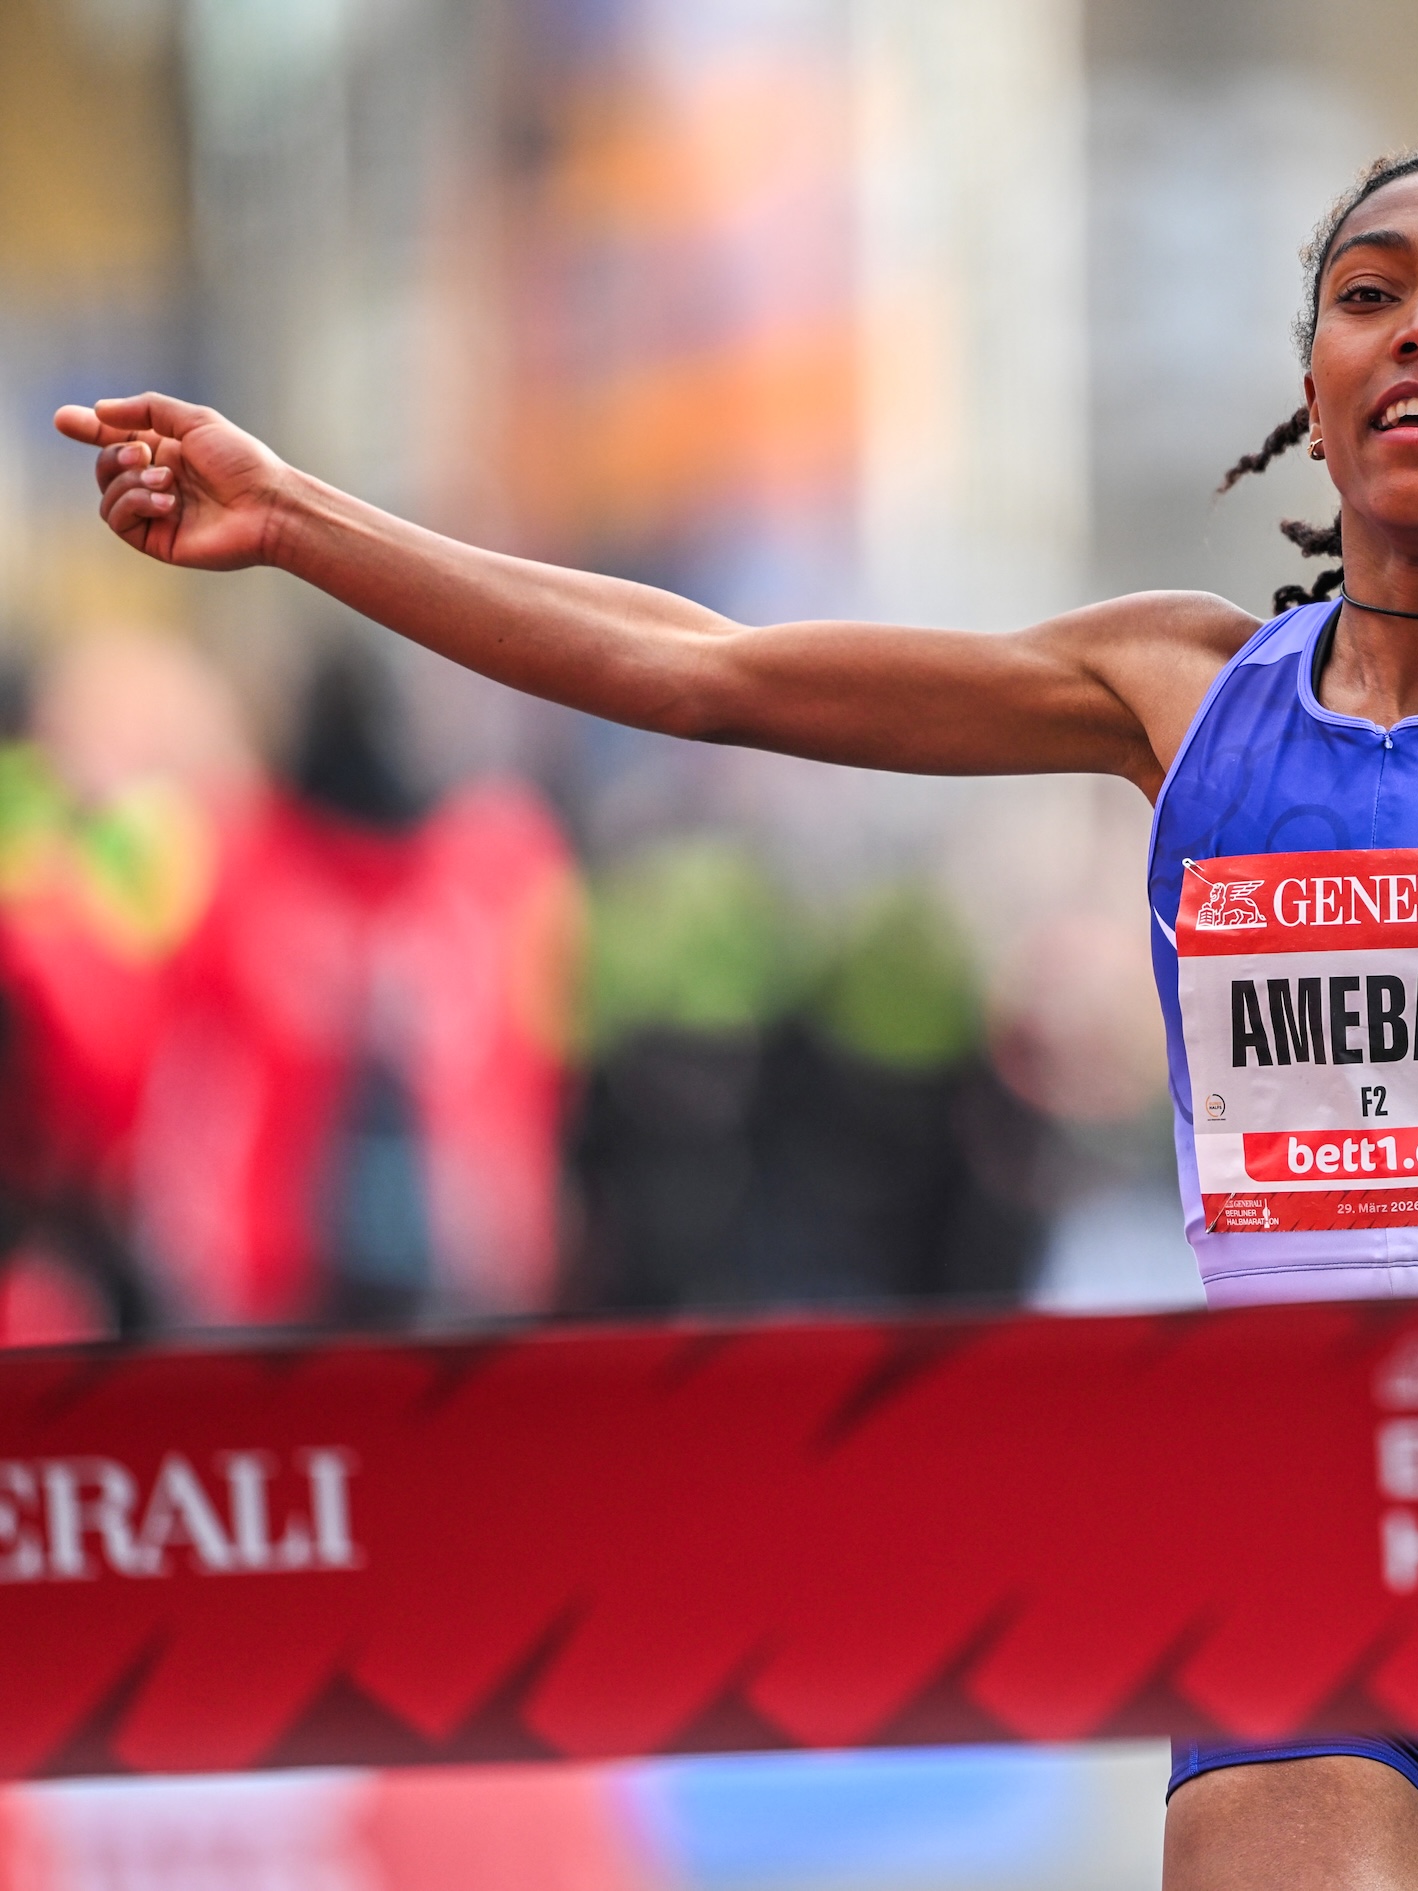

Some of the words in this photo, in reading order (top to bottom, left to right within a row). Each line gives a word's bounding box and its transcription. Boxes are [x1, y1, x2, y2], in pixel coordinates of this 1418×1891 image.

[1361, 1086, 1388, 1117] F2
[1233, 1200, 1262, 1208] GENERALI
[1337, 1203, 1356, 1214] 29.
[1358, 1202, 1388, 1213] März
[1225, 1209, 1257, 1217] BERLINER
[1226, 1217, 1279, 1226] HALBMARATON
